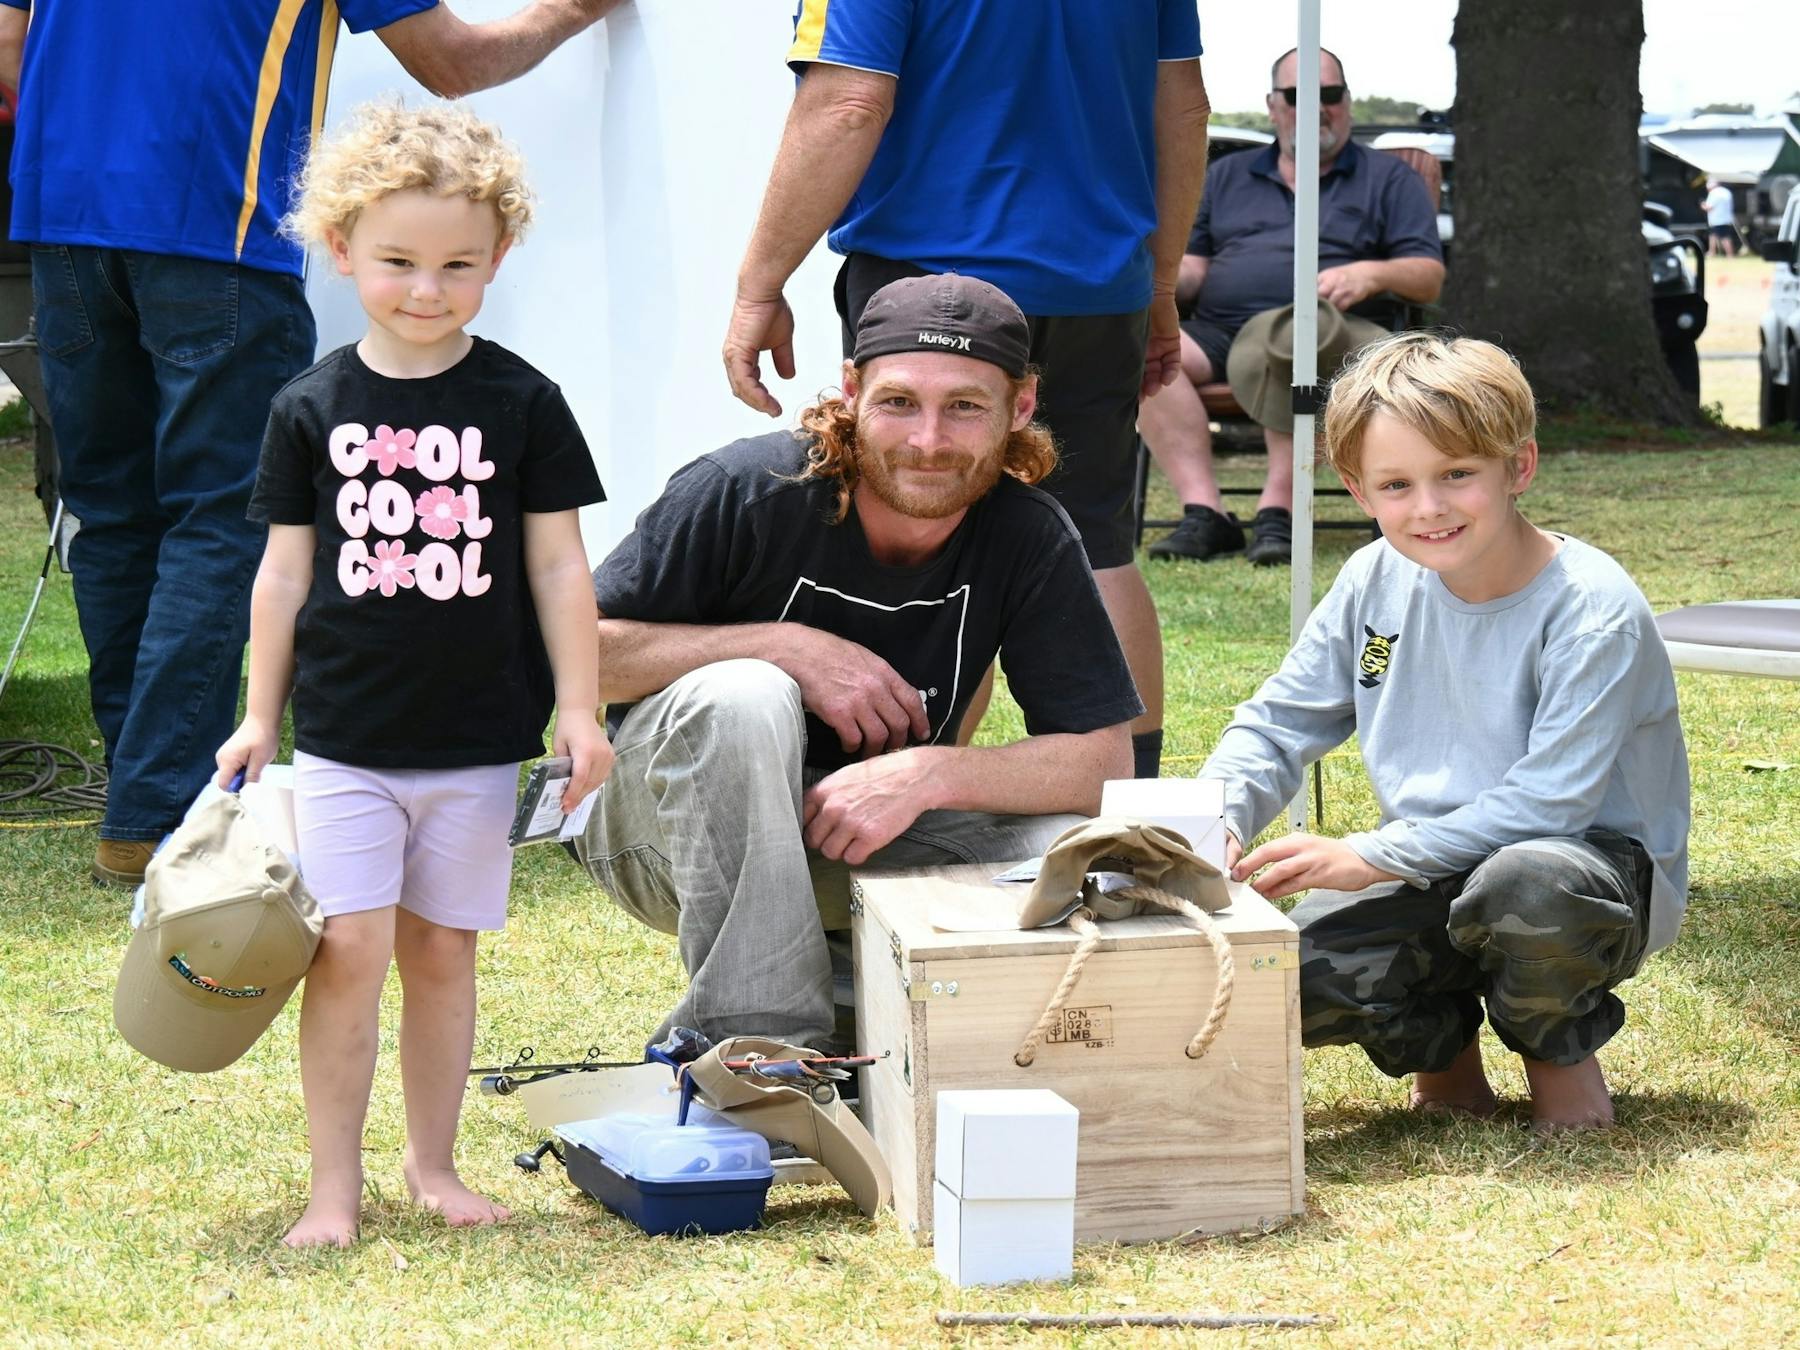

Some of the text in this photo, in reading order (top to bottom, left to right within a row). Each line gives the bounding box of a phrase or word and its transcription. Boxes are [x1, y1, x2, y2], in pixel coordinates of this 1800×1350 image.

[918, 333, 958, 347] Hurley
[192, 978, 262, 997] OUTDOORS
[1070, 1030, 1091, 1040] MB
